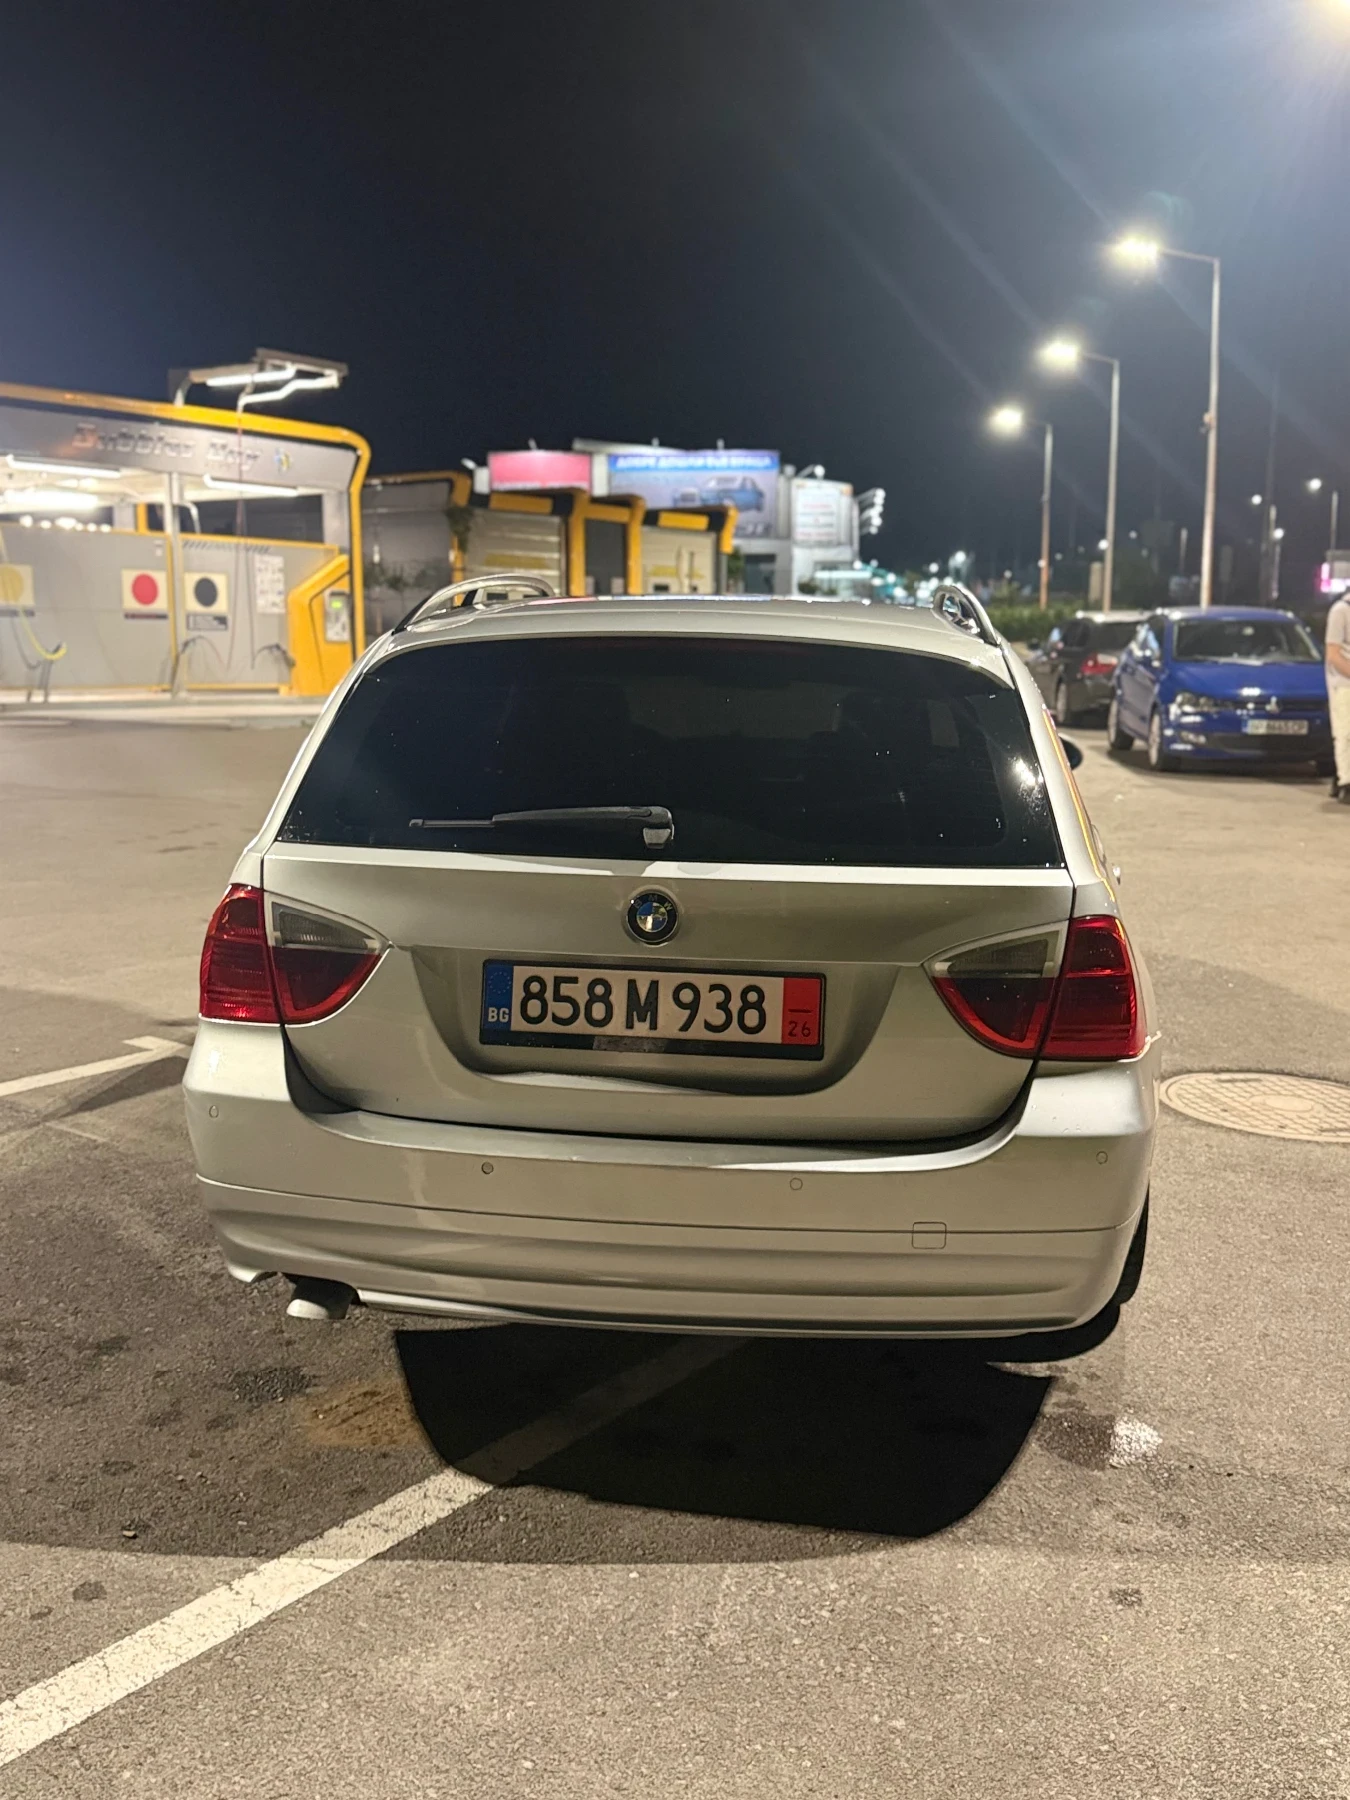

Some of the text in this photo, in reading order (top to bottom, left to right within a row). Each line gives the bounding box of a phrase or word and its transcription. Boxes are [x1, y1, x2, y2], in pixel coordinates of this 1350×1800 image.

[634, 894, 673, 911] BMW
[488, 976, 812, 1038] BG 858 M 938 26
